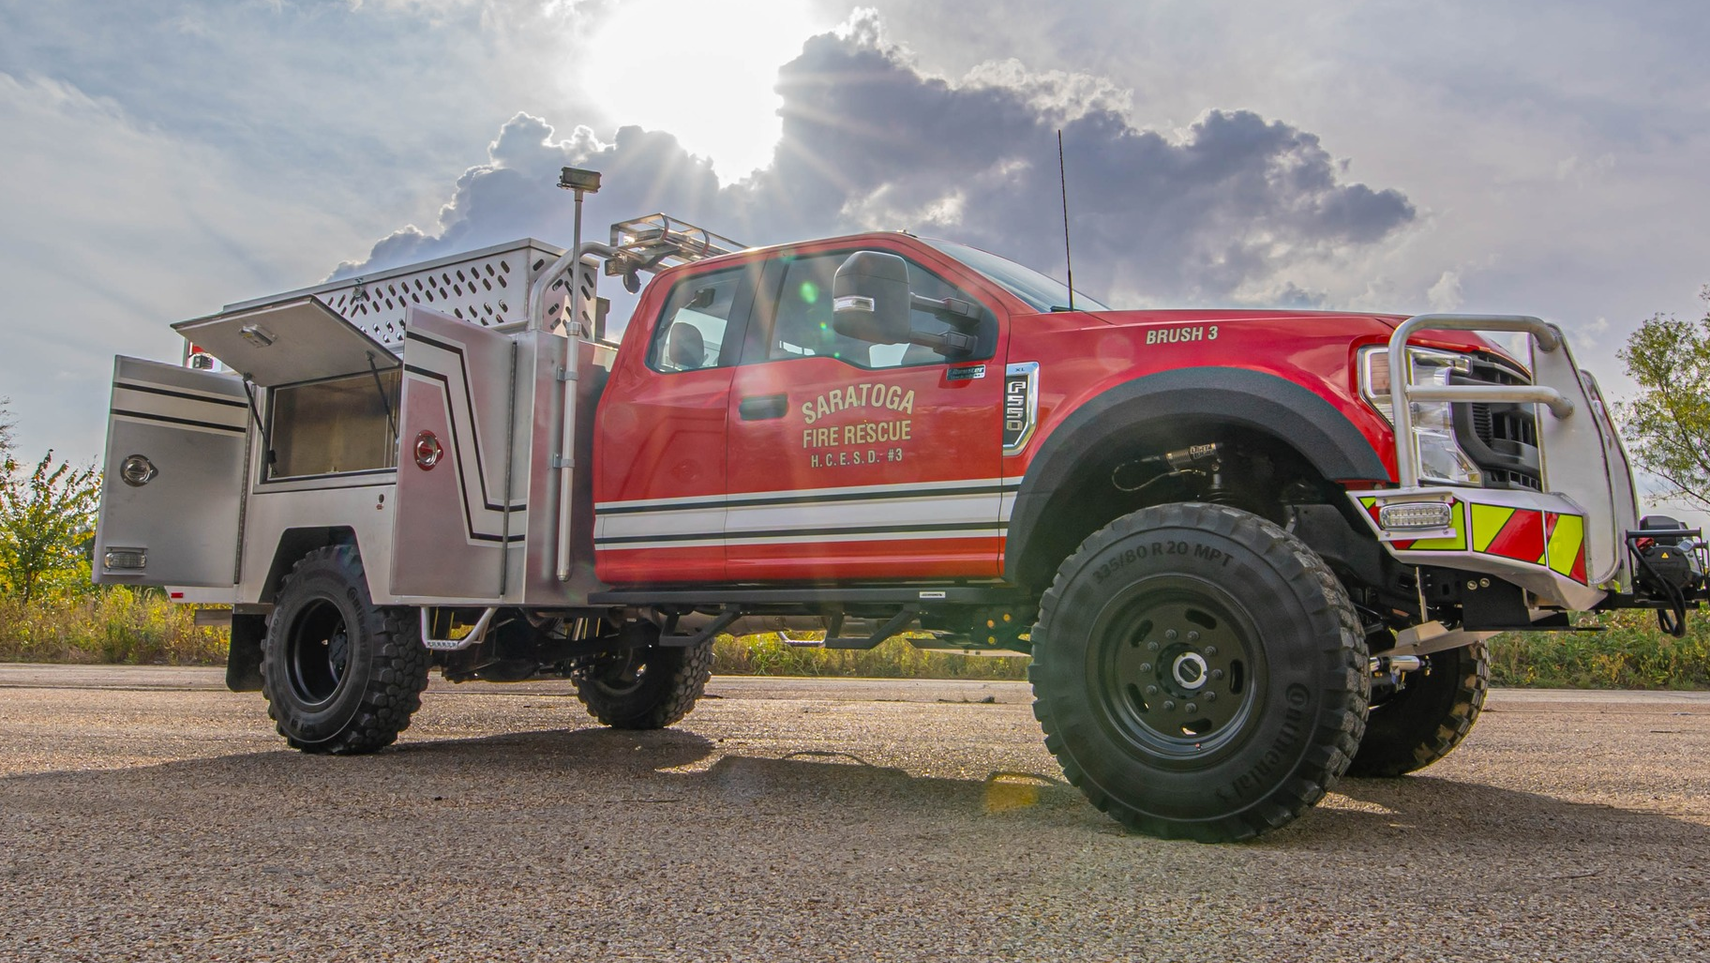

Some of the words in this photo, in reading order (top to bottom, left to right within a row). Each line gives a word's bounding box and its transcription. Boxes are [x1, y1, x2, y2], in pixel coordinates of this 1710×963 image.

[1146, 326, 1203, 344] BRUSH
[1208, 325, 1218, 340] 3
[801, 383, 915, 424] SARATOGA
[803, 426, 839, 448] FIRE
[844, 420, 911, 445] RESCUE
[887, 448, 902, 462] #3
[1093, 545, 1148, 584] 335/80
[1151, 542, 1163, 556] R
[1166, 540, 1189, 555] 20
[1194, 543, 1234, 567] MPT
